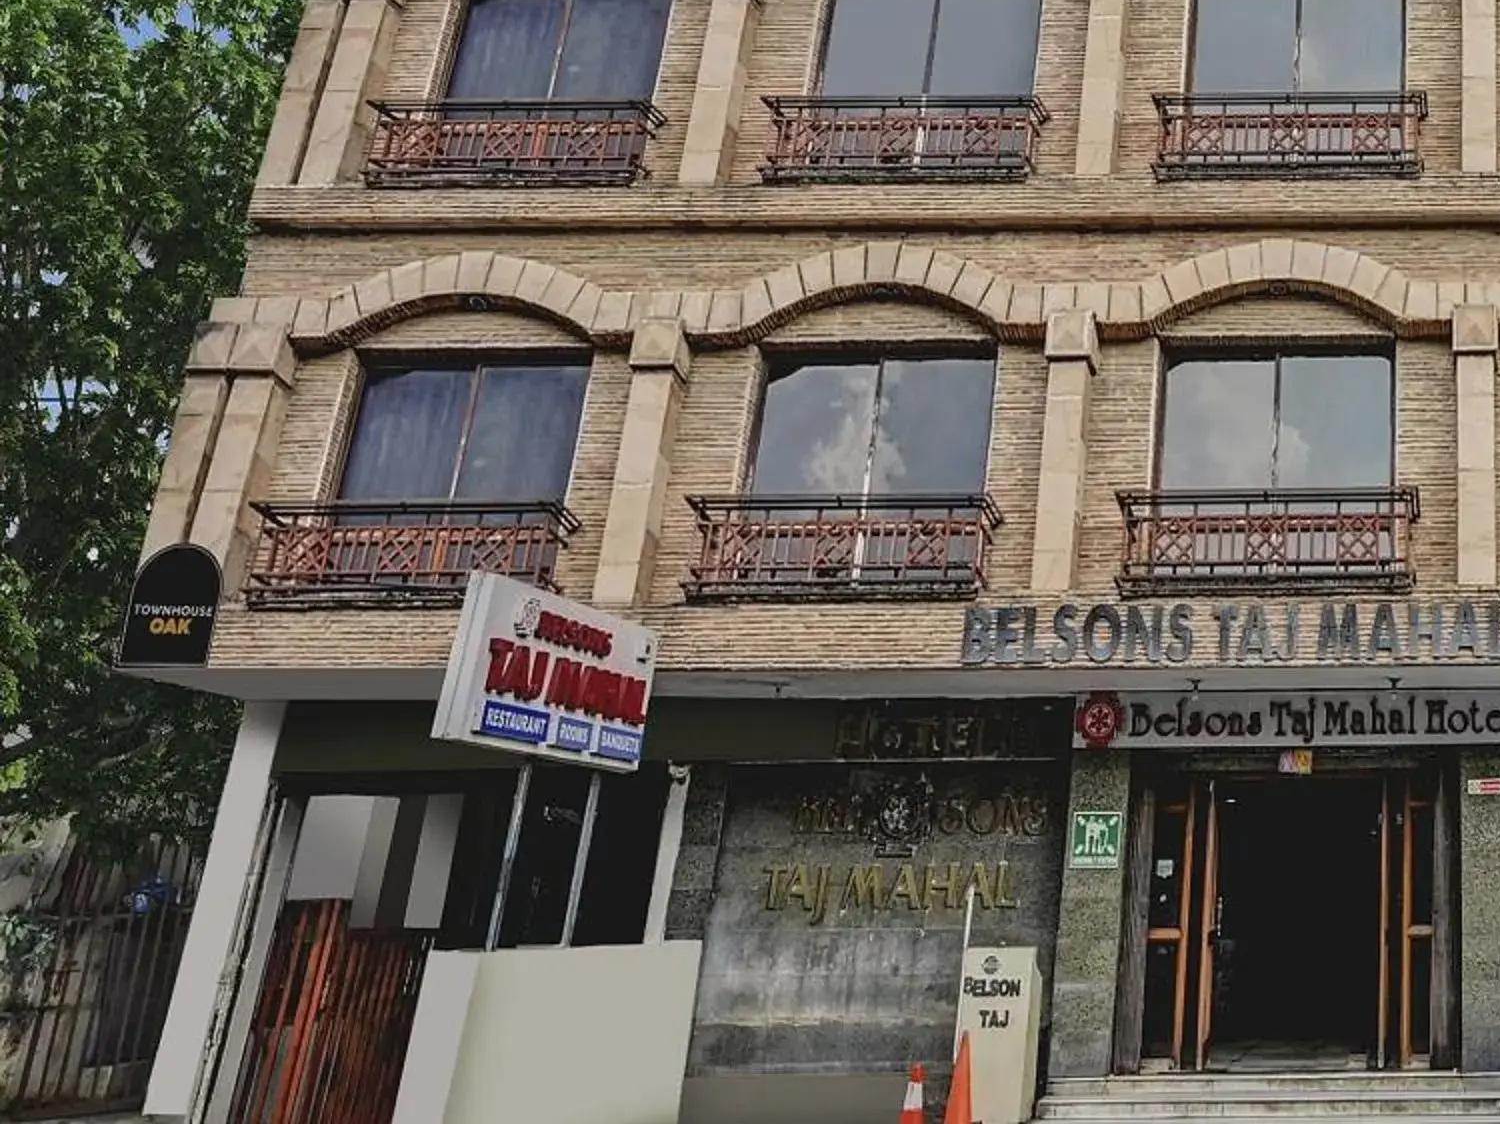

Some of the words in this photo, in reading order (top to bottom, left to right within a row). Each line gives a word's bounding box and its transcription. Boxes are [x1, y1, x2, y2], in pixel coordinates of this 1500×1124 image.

[134, 604, 214, 617] TOWNHOUSE
[149, 617, 193, 635] OAK
[960, 603, 1193, 664] BELSONS
[1212, 603, 1299, 661] TAJ
[485, 637, 549, 701] TAJ
[486, 707, 548, 736] RESTAURANT
[1128, 696, 1263, 738] Belsons
[1269, 696, 1316, 743] Taj
[1323, 695, 1417, 736] Mahal
[763, 860, 831, 925] TAJ
[839, 859, 1020, 912] MAHAL
[963, 977, 1021, 997] BELSON
[979, 1010, 1010, 1028] TAJ
